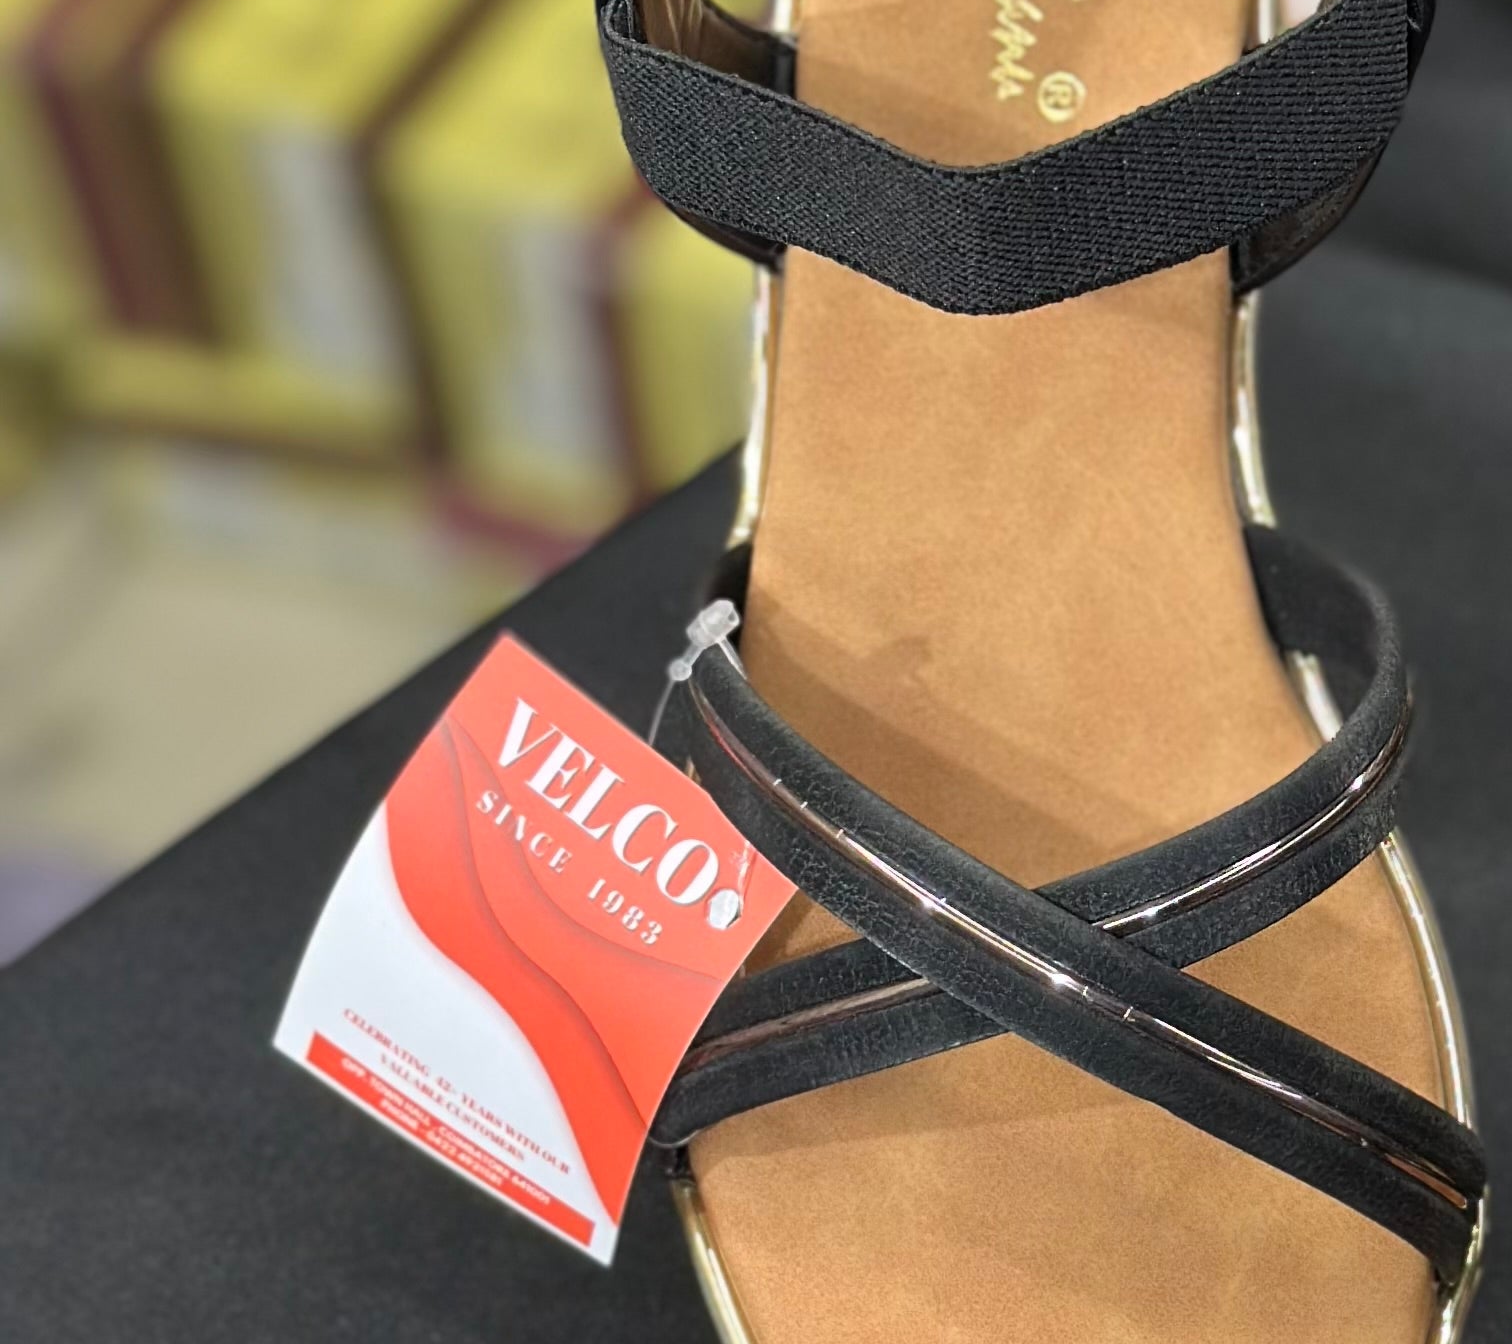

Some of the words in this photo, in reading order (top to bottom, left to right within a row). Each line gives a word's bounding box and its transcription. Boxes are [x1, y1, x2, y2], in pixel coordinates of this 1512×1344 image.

[477, 789, 574, 874] SINCE
[587, 878, 663, 945] 1983
[498, 696, 720, 906] VELCO
[343, 1007, 430, 1077] CELEBRATING
[461, 1092, 503, 1129] YEARS
[503, 1122, 541, 1156] WITH
[444, 1102, 525, 1162] CUSTOMERS
